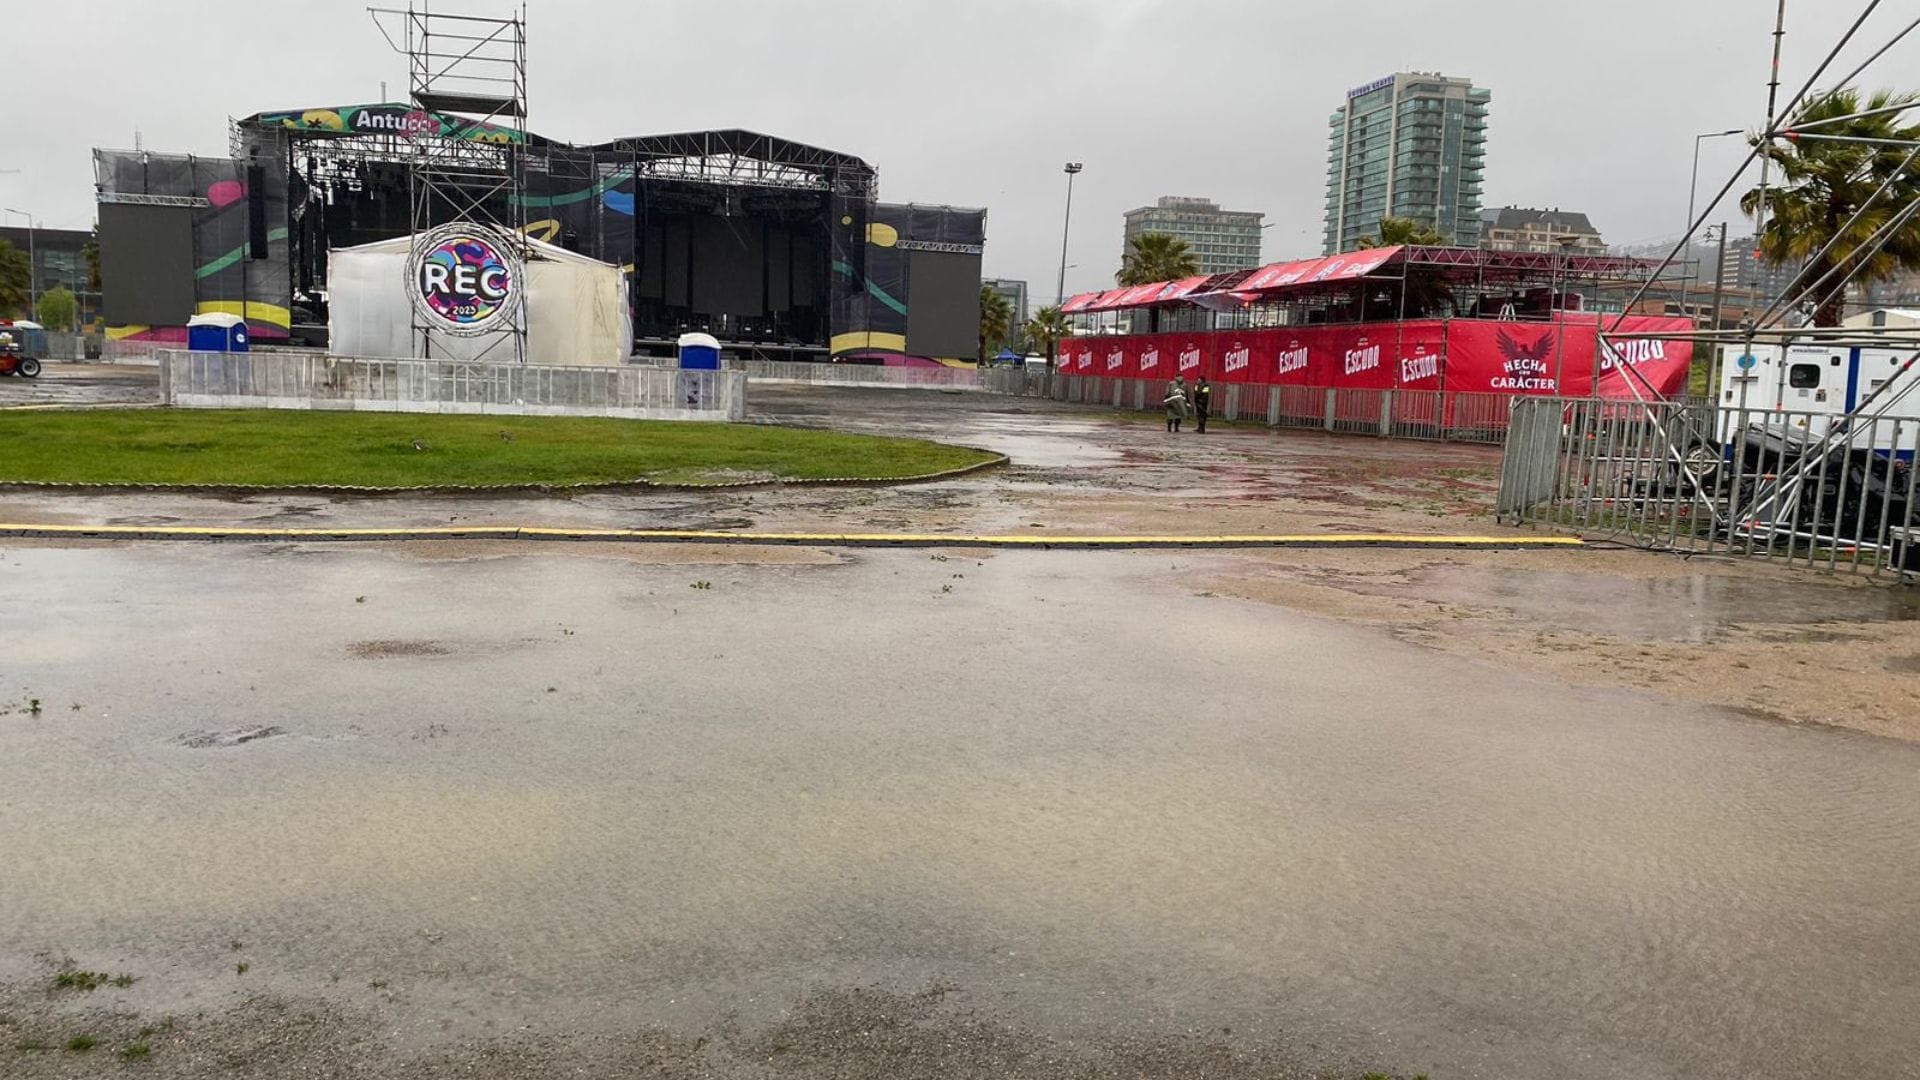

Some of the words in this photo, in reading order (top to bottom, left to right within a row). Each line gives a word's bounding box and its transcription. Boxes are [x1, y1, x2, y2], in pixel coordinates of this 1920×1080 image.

[424, 263, 507, 298] REC
[452, 306, 476, 315] 2023
[1279, 347, 1308, 374] ESCUDO
[1345, 345, 1380, 375] ESCUDO
[1402, 354, 1438, 383] ESCUDO
[1503, 359, 1548, 374] HECHA
[1601, 339, 1664, 370] SCUDO
